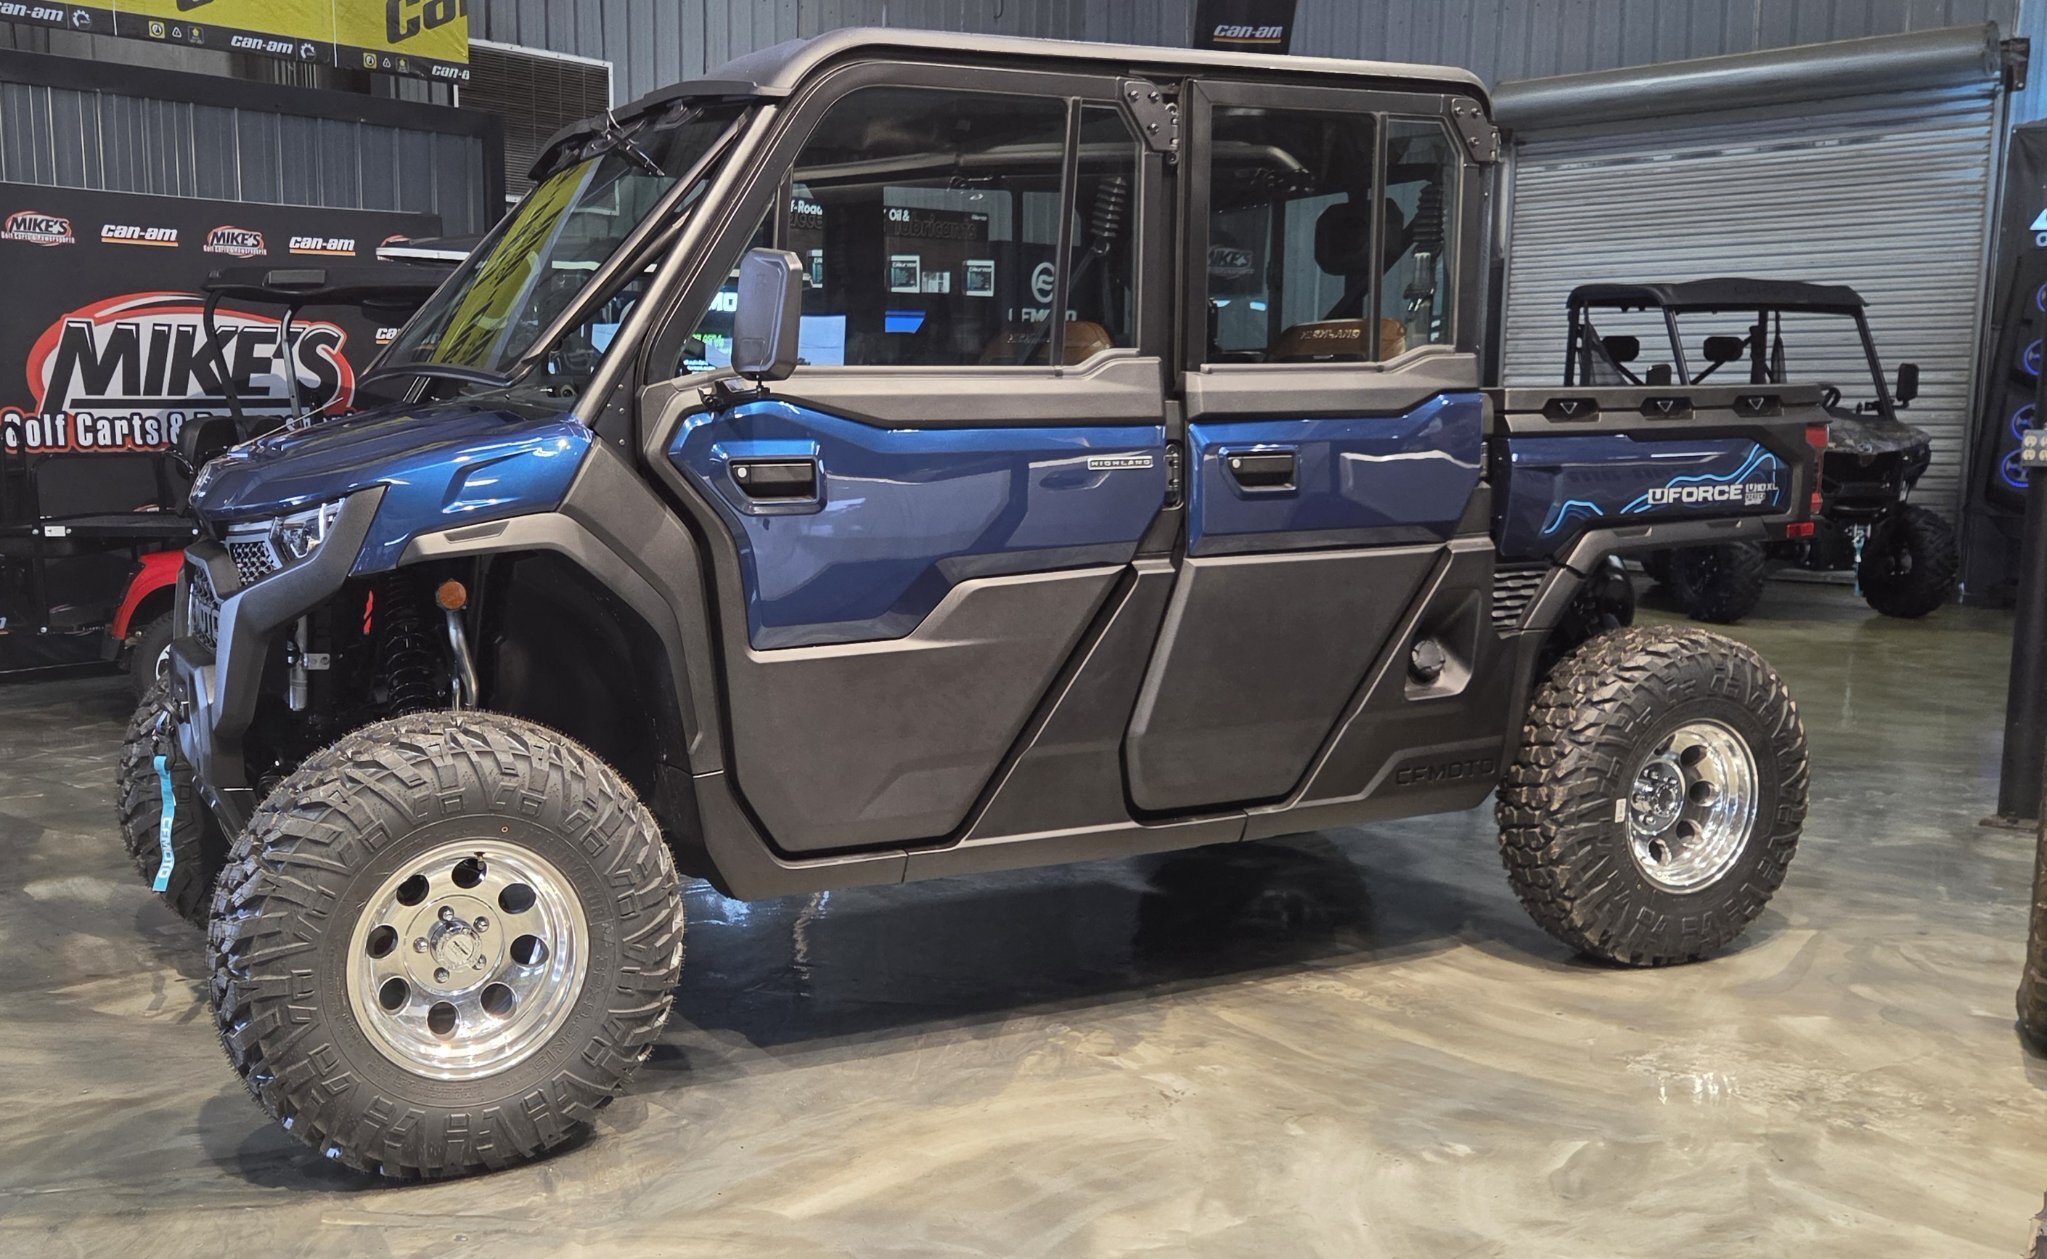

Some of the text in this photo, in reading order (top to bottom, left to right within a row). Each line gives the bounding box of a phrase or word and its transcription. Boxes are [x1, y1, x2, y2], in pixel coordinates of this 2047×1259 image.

[0, 1, 64, 22] an-am
[386, 0, 468, 44] Ca
[1213, 24, 1283, 38] can-am
[230, 34, 293, 55] can-am
[9, 216, 69, 235] MIKE'S
[101, 224, 178, 241] can-am
[210, 231, 261, 248] MIKE'S
[288, 236, 355, 251] can-am
[375, 327, 401, 340] ca
[4, 413, 66, 447] Golf
[76, 413, 160, 446] Carts
[1090, 458, 1151, 468] HIGHLAND
[1648, 484, 1743, 505] UFORCE
